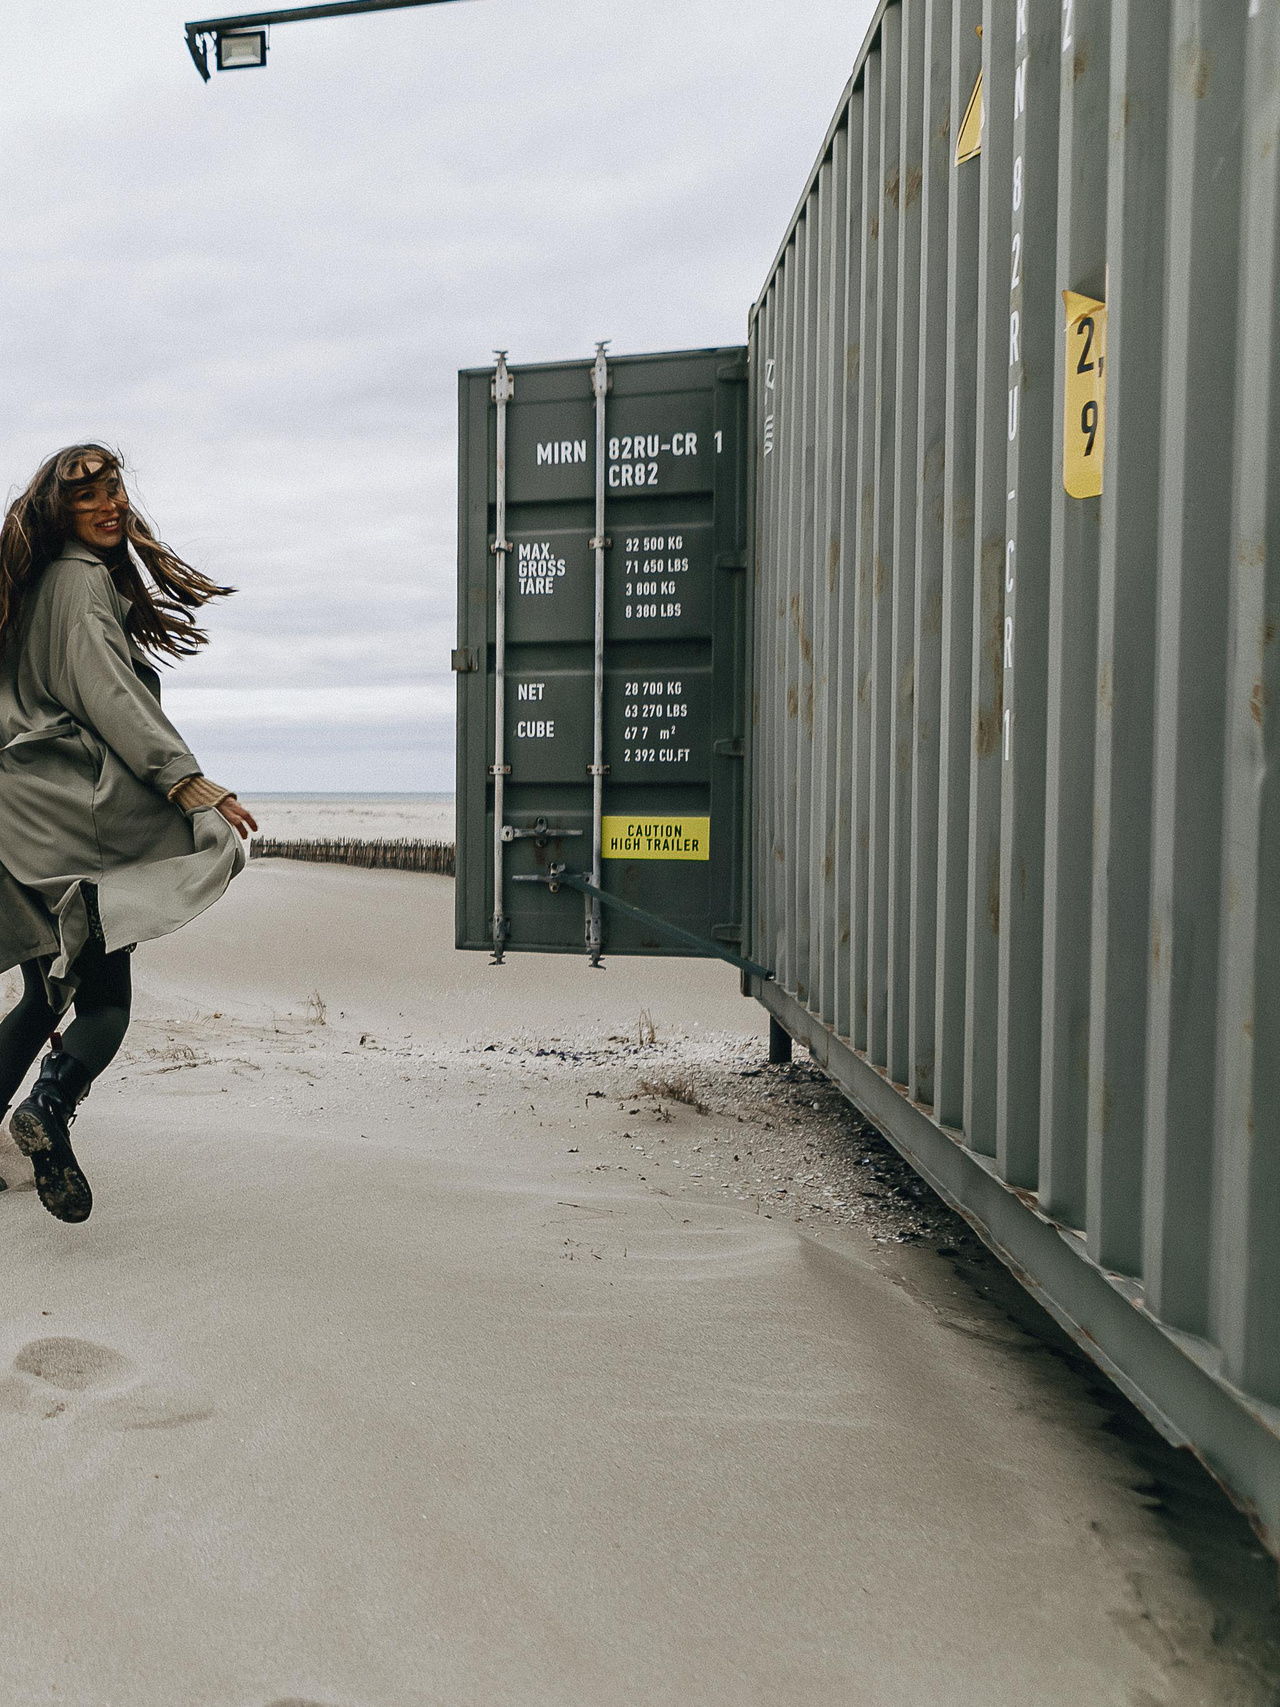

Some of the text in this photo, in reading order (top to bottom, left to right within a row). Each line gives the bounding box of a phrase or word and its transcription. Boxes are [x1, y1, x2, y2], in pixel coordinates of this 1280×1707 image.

[1080, 400, 1098, 458] 9
[536, 430, 723, 466] MIRN 82RU-CR 1
[608, 462, 659, 488] CR82
[518, 543, 555, 561] MAX.
[625, 535, 683, 552] 32 500 KG
[518, 559, 566, 578] GROSS
[625, 557, 689, 574] 71 650 LBS
[519, 577, 554, 595] TARE
[625, 580, 676, 596] 3 800 KG
[625, 602, 682, 619] 8 380 LBS
[518, 683, 545, 701] NET
[624, 681, 682, 696] 28 700 KG
[624, 703, 688, 718] 63 270 LBS
[517, 721, 555, 738] CUBE
[624, 726, 638, 740] 67
[624, 748, 691, 762] 2 392 CU.FT
[627, 824, 683, 838] CAUTION
[611, 838, 700, 852] HIGH TRAILER
